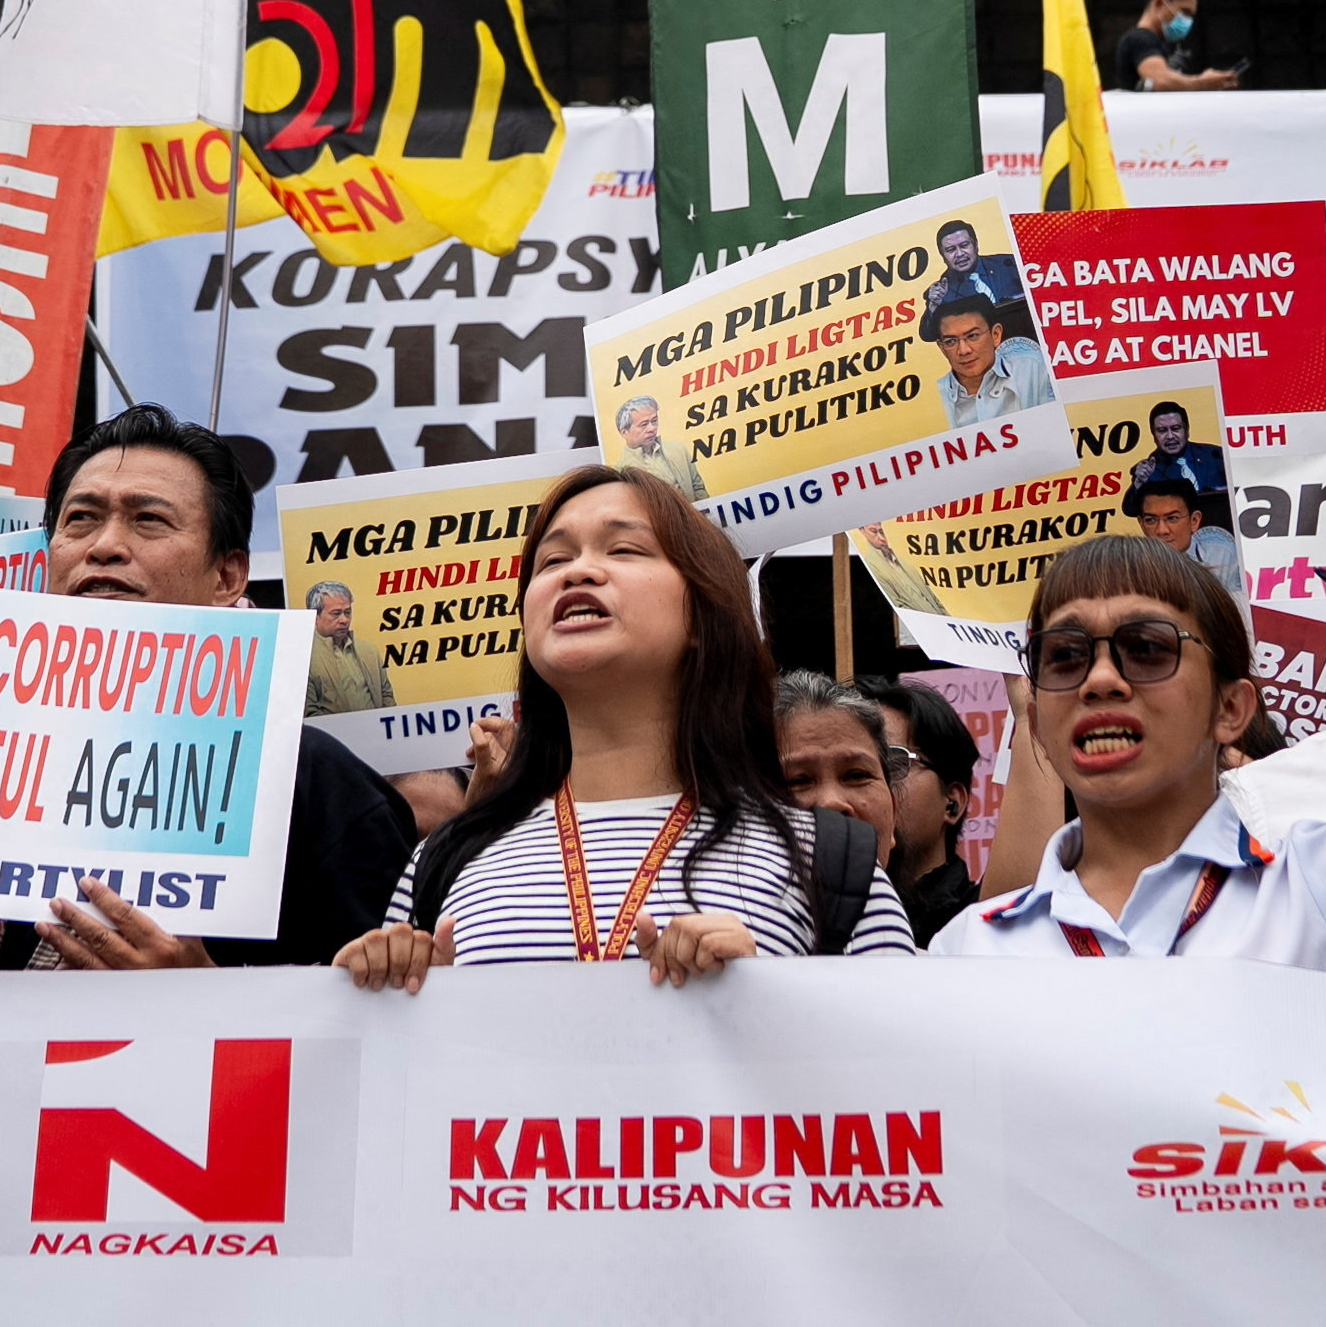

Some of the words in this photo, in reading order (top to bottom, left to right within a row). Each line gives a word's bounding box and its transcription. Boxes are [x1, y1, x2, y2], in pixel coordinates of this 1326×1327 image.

[1073, 256, 1155, 286] BATA
[1158, 251, 1295, 282] WALANG
[613, 320, 716, 387] MGA
[722, 245, 930, 344] PILIPINO
[1110, 295, 1177, 324] SILA
[1181, 292, 1249, 321] MAY
[1257, 290, 1295, 317] LV
[679, 341, 778, 398] HINDI
[785, 297, 917, 360] LIGTAS
[1104, 336, 1146, 365] AT
[1150, 331, 1269, 362] CHANEL
[684, 392, 729, 431] SA
[734, 336, 915, 410] KURAKOT
[691, 429, 738, 463] NA
[744, 373, 921, 447] PULITIKO
[831, 422, 1020, 497] PILIPINAS
[992, 470, 1123, 517] LIGTAS
[305, 519, 417, 565] MGA
[906, 533, 941, 558] SA
[945, 507, 1116, 555] KURAKOT
[375, 560, 480, 596] HINDI
[921, 566, 954, 590] NA
[379, 603, 424, 632] SA
[947, 620, 1023, 650] TINDIG
[382, 639, 429, 669] NA
[62, 729, 243, 845] AGAIN!
[568, 850, 582, 872] THE
[607, 873, 652, 955] POLYTECHNIC
[643, 811, 685, 872] UNIVERSITY
[570, 872, 594, 944] PHILIPPINES
[448, 1109, 945, 1182] KALIPUNAN
[448, 1182, 528, 1212] NG
[546, 1181, 792, 1211] KILUSANG
[810, 1180, 944, 1210] MASA
[1136, 1179, 1307, 1199] Simbahan
[1175, 1194, 1279, 1213] Laban
[29, 1232, 280, 1257] NAGKAISA
